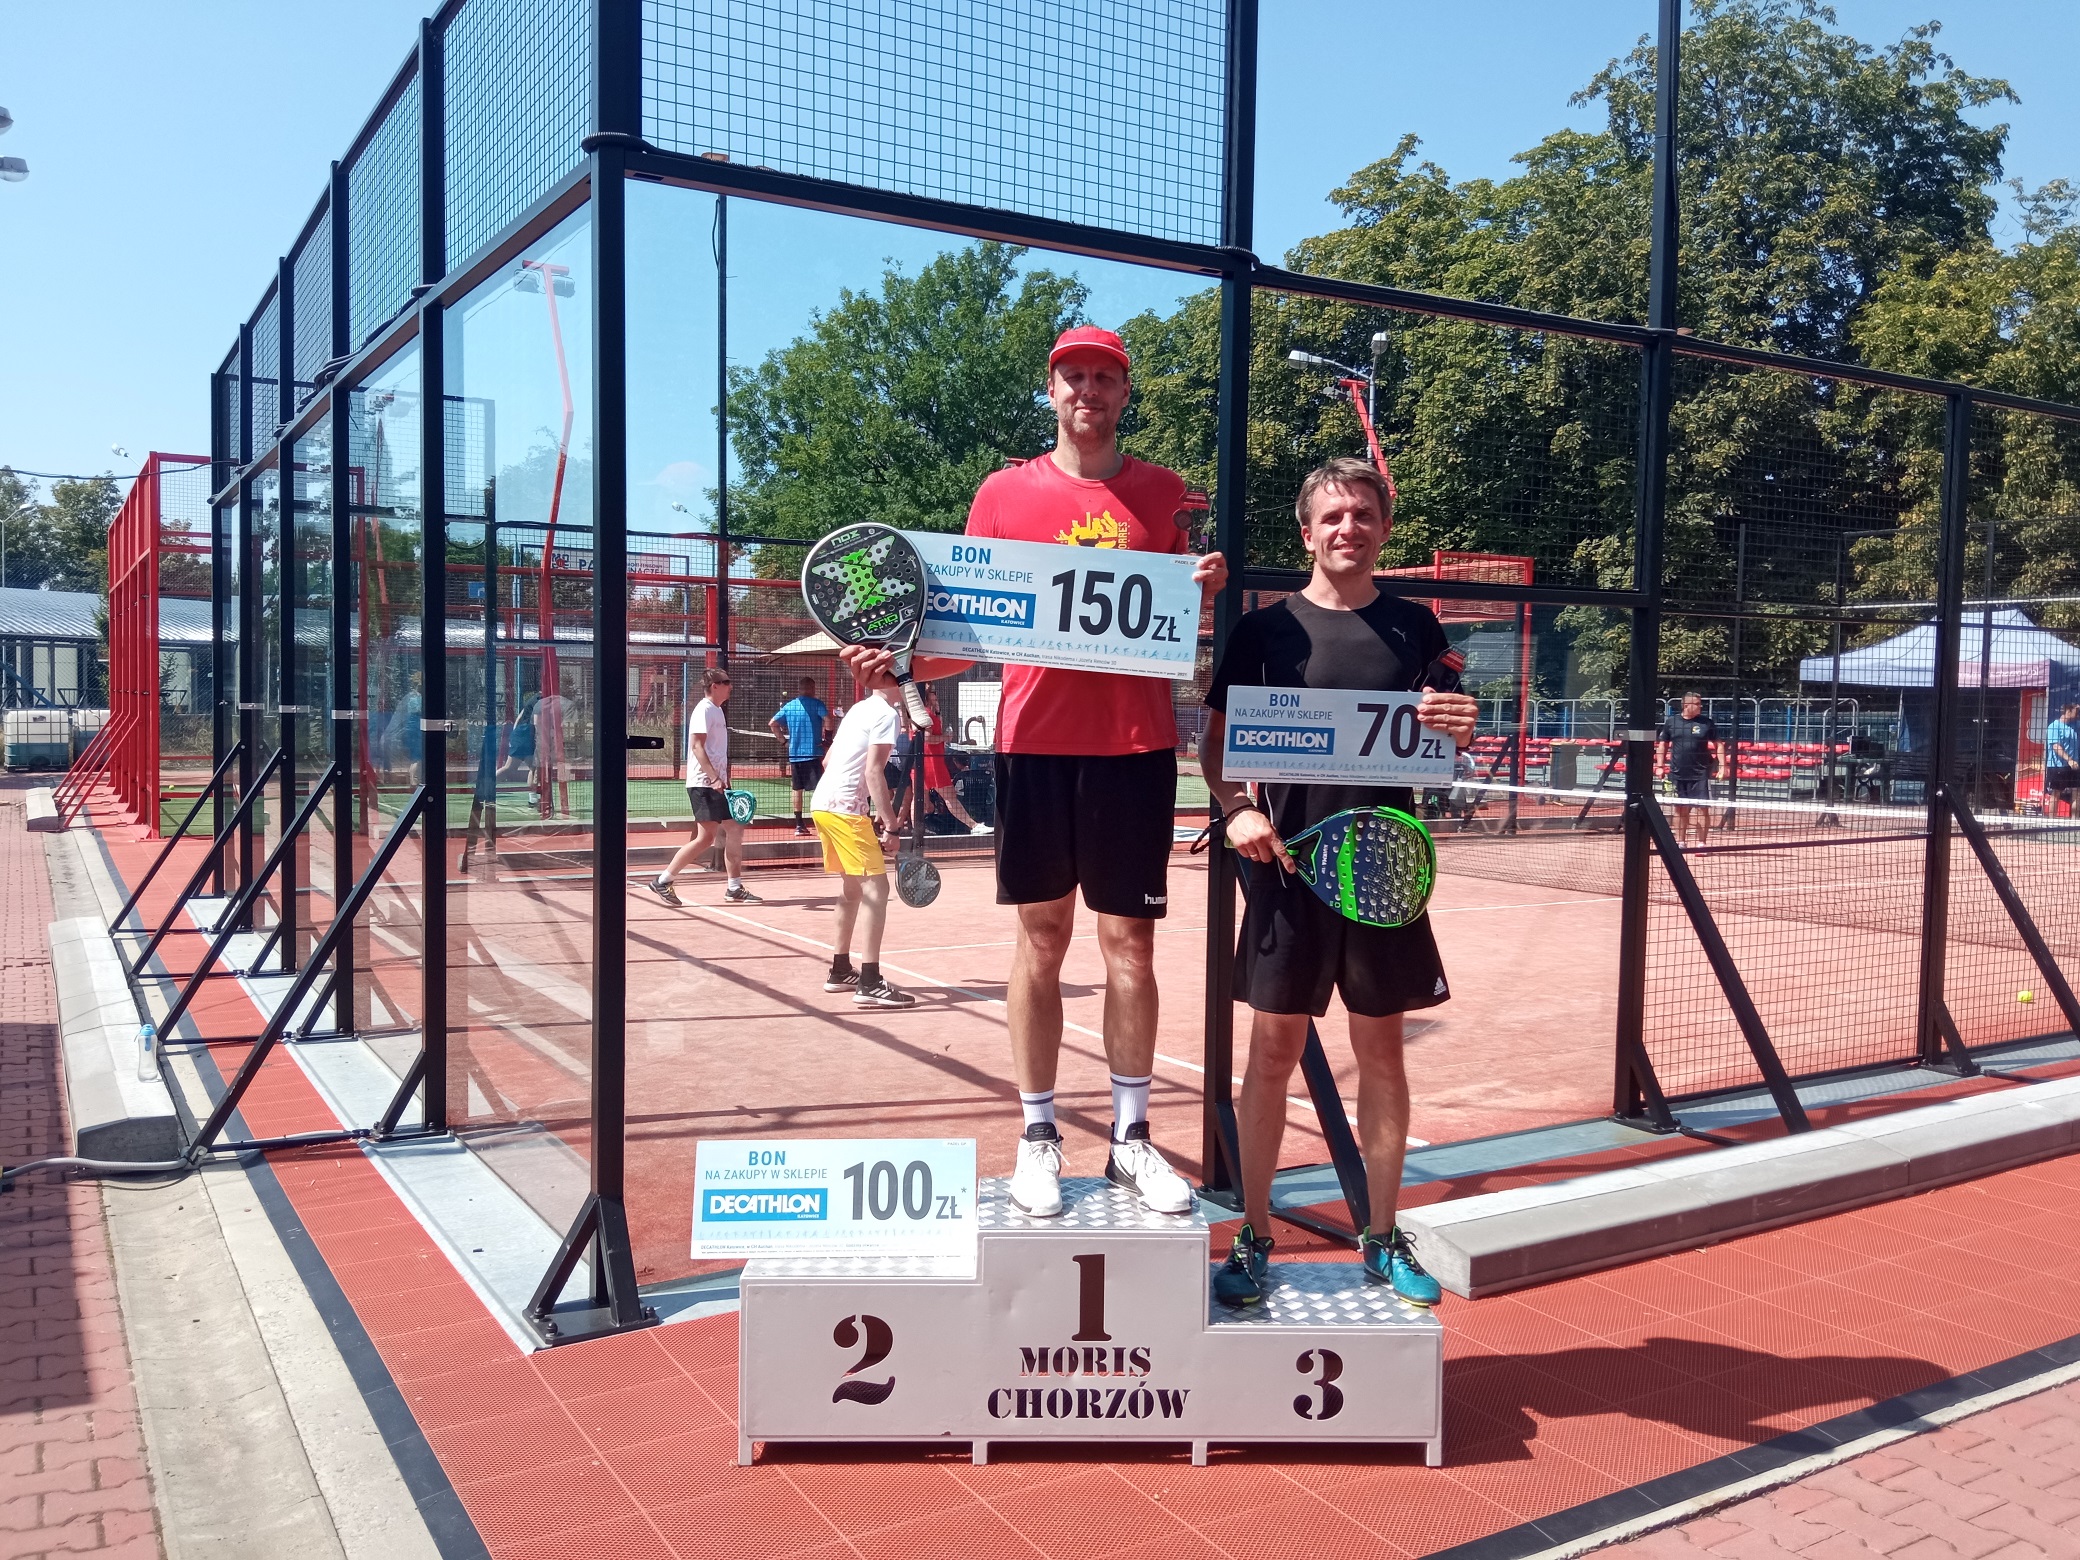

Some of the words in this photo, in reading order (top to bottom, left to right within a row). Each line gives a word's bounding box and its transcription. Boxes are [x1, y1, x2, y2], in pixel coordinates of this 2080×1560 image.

[951, 545, 992, 565] BON
[927, 563, 971, 578] ZAKUPY
[974, 567, 985, 579] W
[987, 568, 1034, 583] SKLEPIE
[927, 591, 1027, 620] ECATHLON
[1052, 569, 1153, 639] 150
[1151, 615, 1181, 642] ZŁ
[1000, 619, 1025, 627] KATOWICE
[1269, 693, 1300, 707] BON
[1234, 708, 1248, 717] NA
[1249, 708, 1285, 718] ZAKUPY
[1287, 710, 1296, 718] W
[1297, 710, 1333, 720] SKLEPIE
[1235, 730, 1329, 748] DECATHLON
[1357, 703, 1421, 758] 70
[1420, 738, 1446, 759] ZŁ
[748, 1150, 786, 1166] BON
[705, 1170, 721, 1180] NA
[723, 1169, 768, 1180] ZAKUPY
[770, 1169, 781, 1179] W
[783, 1168, 828, 1179] SKLEPIE
[843, 1160, 933, 1220] 100
[935, 1195, 963, 1219] ZŁ
[709, 1193, 821, 1214] DECATHLON
[1071, 1253, 1112, 1341] 1
[832, 1314, 896, 1406] 2
[1018, 1347, 1152, 1377] MORIS
[1292, 1348, 1345, 1421] 3
[987, 1381, 1192, 1419] CHORZÓW
